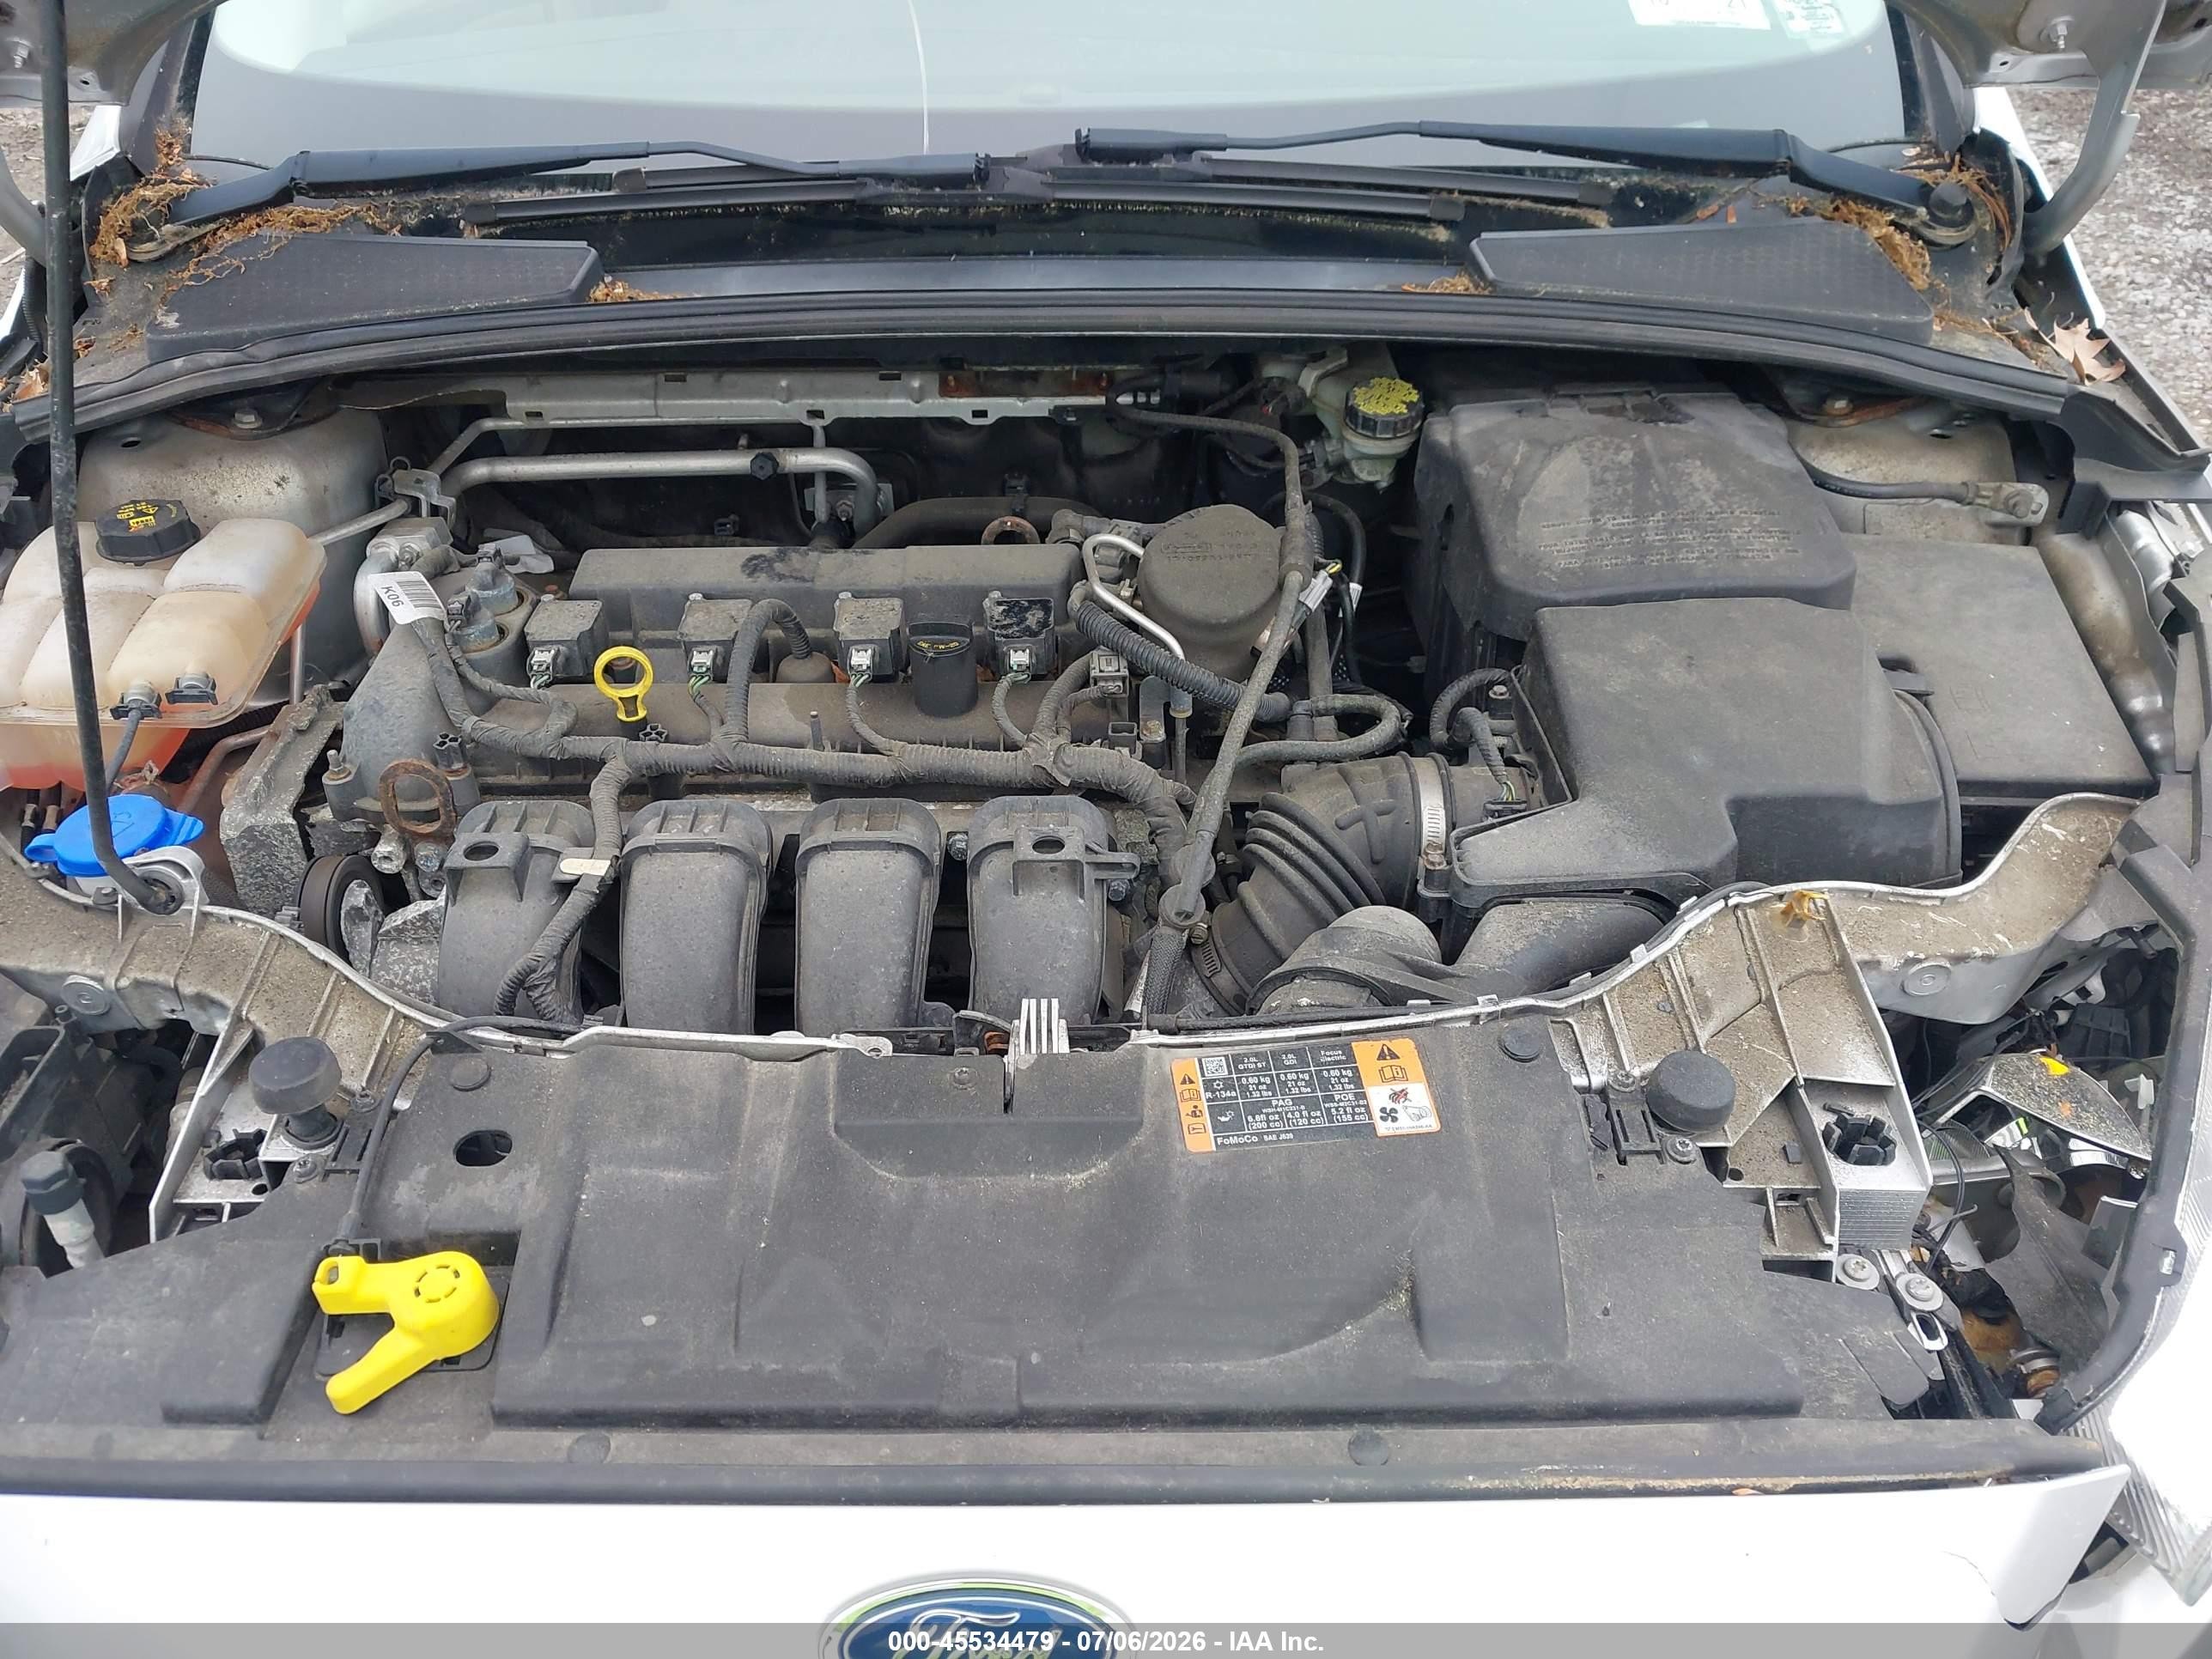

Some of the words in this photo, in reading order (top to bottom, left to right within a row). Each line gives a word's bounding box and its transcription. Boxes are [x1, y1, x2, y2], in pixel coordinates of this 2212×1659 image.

[380, 586, 404, 607] K06
[1205, 1091, 1237, 1099] R-134a
[1334, 1093, 1356, 1102] POE
[1272, 1098, 1293, 1107] PAG
[1331, 1107, 1345, 1115] 5.2
[1289, 1118, 1309, 1127] (120
[1310, 1116, 1324, 1125] cc)
[1334, 1115, 1352, 1124] (155
[1354, 1113, 1369, 1121] cc)
[1249, 1122, 1267, 1131] (200
[1269, 1120, 1284, 1128] cc)
[1217, 1134, 1258, 1146] FoMoCo
